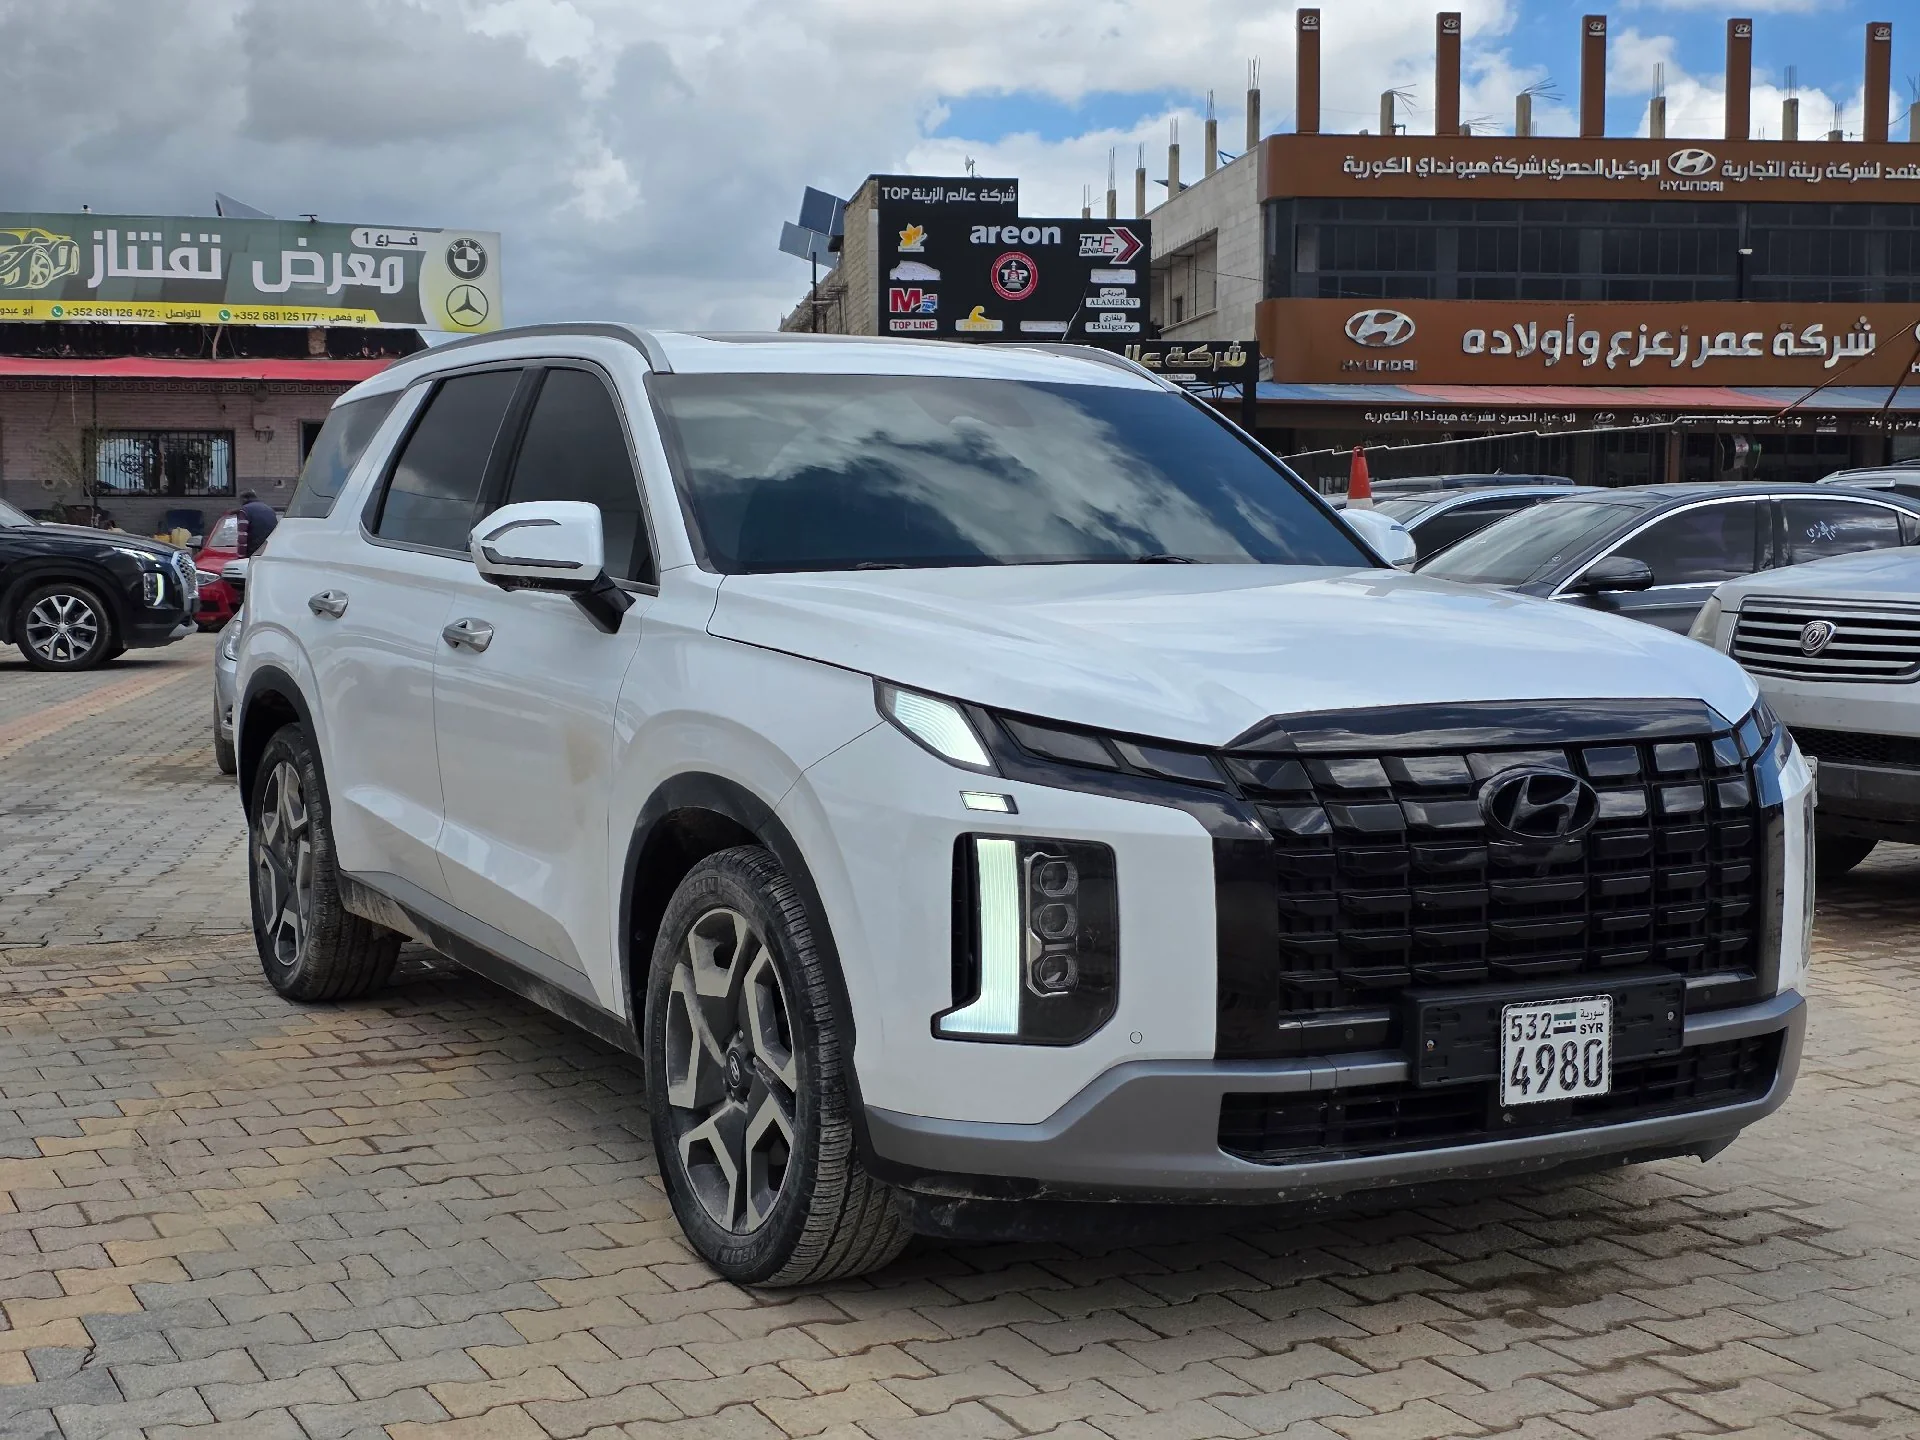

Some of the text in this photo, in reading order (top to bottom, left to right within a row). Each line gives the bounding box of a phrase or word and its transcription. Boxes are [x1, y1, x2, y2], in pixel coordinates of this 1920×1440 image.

[1343, 155, 1411, 178] الكورية
[1415, 156, 1491, 178] هيونداي
[1547, 158, 1603, 180] الحصري
[1604, 158, 1660, 180] الوكيل
[1722, 160, 1784, 183] التجارية
[1825, 160, 1880, 183] لشركة
[1660, 180, 1724, 191] HYUNDAI
[881, 185, 1016, 204] شركة عالم الزينة TOP
[362, 231, 418, 247] فرع 1
[969, 225, 1061, 245] areon
[87, 229, 404, 294] معرض تفتناز
[66, 307, 92, 317] +352
[95, 307, 112, 316] 681
[116, 308, 133, 317] 126
[136, 309, 154, 318] 472
[165, 308, 201, 319] للتواصل
[233, 311, 259, 321] +352
[263, 311, 279, 321] 681
[283, 312, 299, 321] 125
[302, 312, 318, 322] 177
[892, 321, 935, 329] TOP LINE
[1092, 323, 1134, 332] Bulgary
[1462, 313, 1876, 370] شركة عمر زعزع وأولاده
[1124, 341, 1247, 372] شركة عال
[1340, 359, 1418, 371] HYUNDAI
[1364, 410, 1408, 424] الكورية
[1410, 410, 1458, 424] هيونداي
[1460, 411, 1496, 425] لشركة
[1499, 411, 1537, 425] الحصري
[1580, 1008, 1605, 1021] سورية
[1511, 1012, 1552, 1042] 532
[1580, 1022, 1604, 1035] SYR
[1511, 1038, 1604, 1096] 4980
